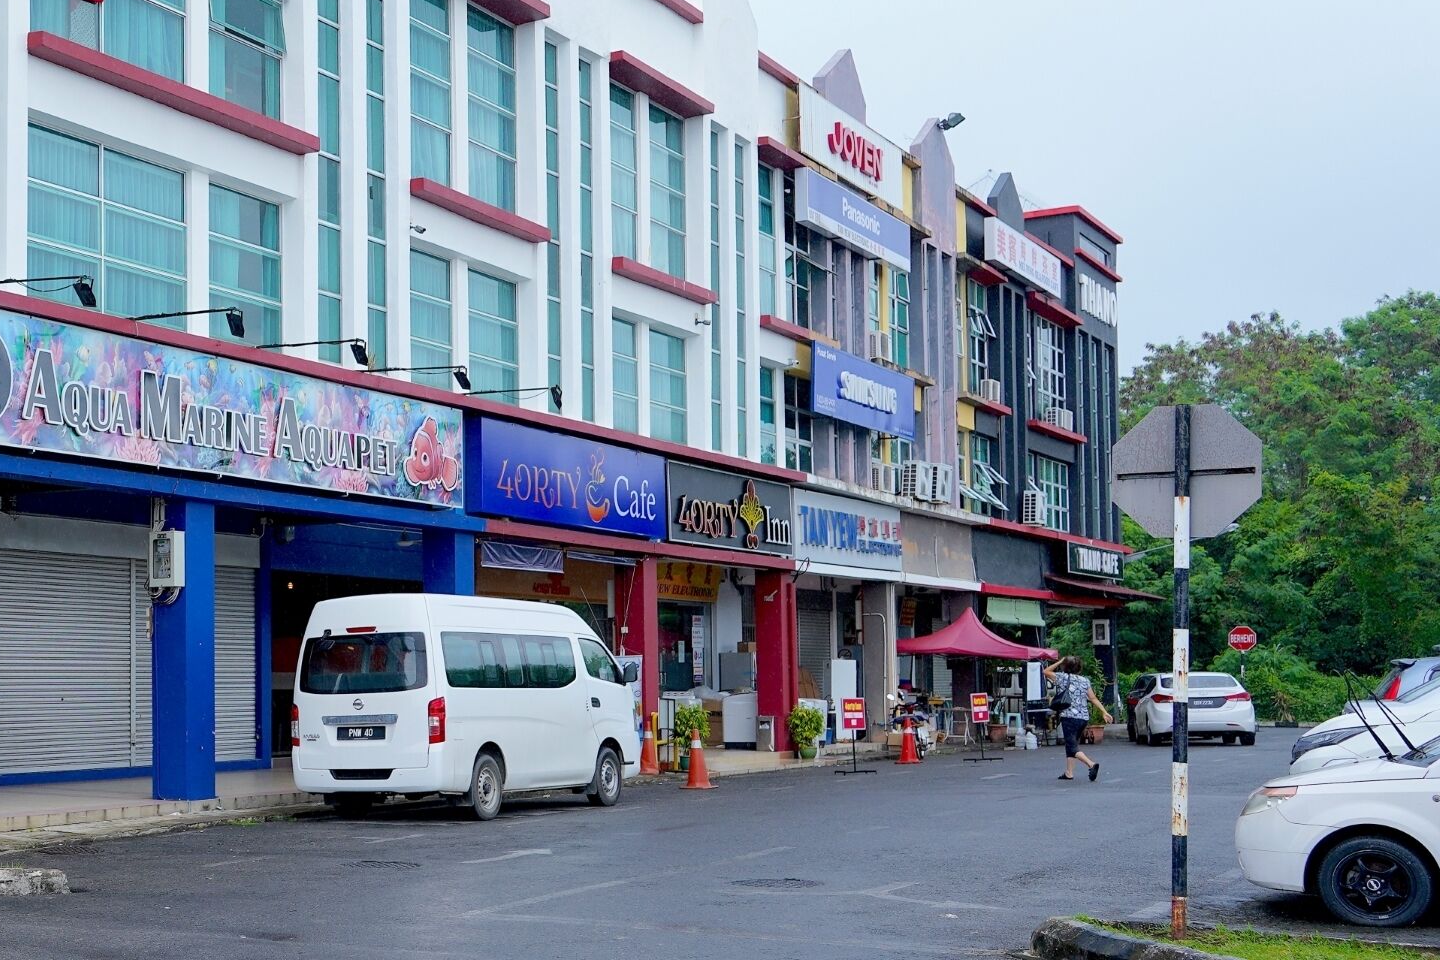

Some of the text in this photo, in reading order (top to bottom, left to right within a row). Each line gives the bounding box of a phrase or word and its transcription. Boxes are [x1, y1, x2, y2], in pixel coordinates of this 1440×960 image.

[827, 121, 884, 182] JOVEN
[842, 195, 881, 236] Panasonic
[21, 348, 399, 477] AQUA MARINE AQUAPET
[838, 370, 897, 416] SAMSUNG
[497, 459, 657, 522] 4ORTY Cafe
[678, 493, 792, 546] 4ORTY Inn
[1102, 551, 1120, 575] CAFE
[672, 584, 716, 598] ELECTRONIC
[1230, 634, 1255, 644] BERHENTI
[364, 728, 373, 737] 40
